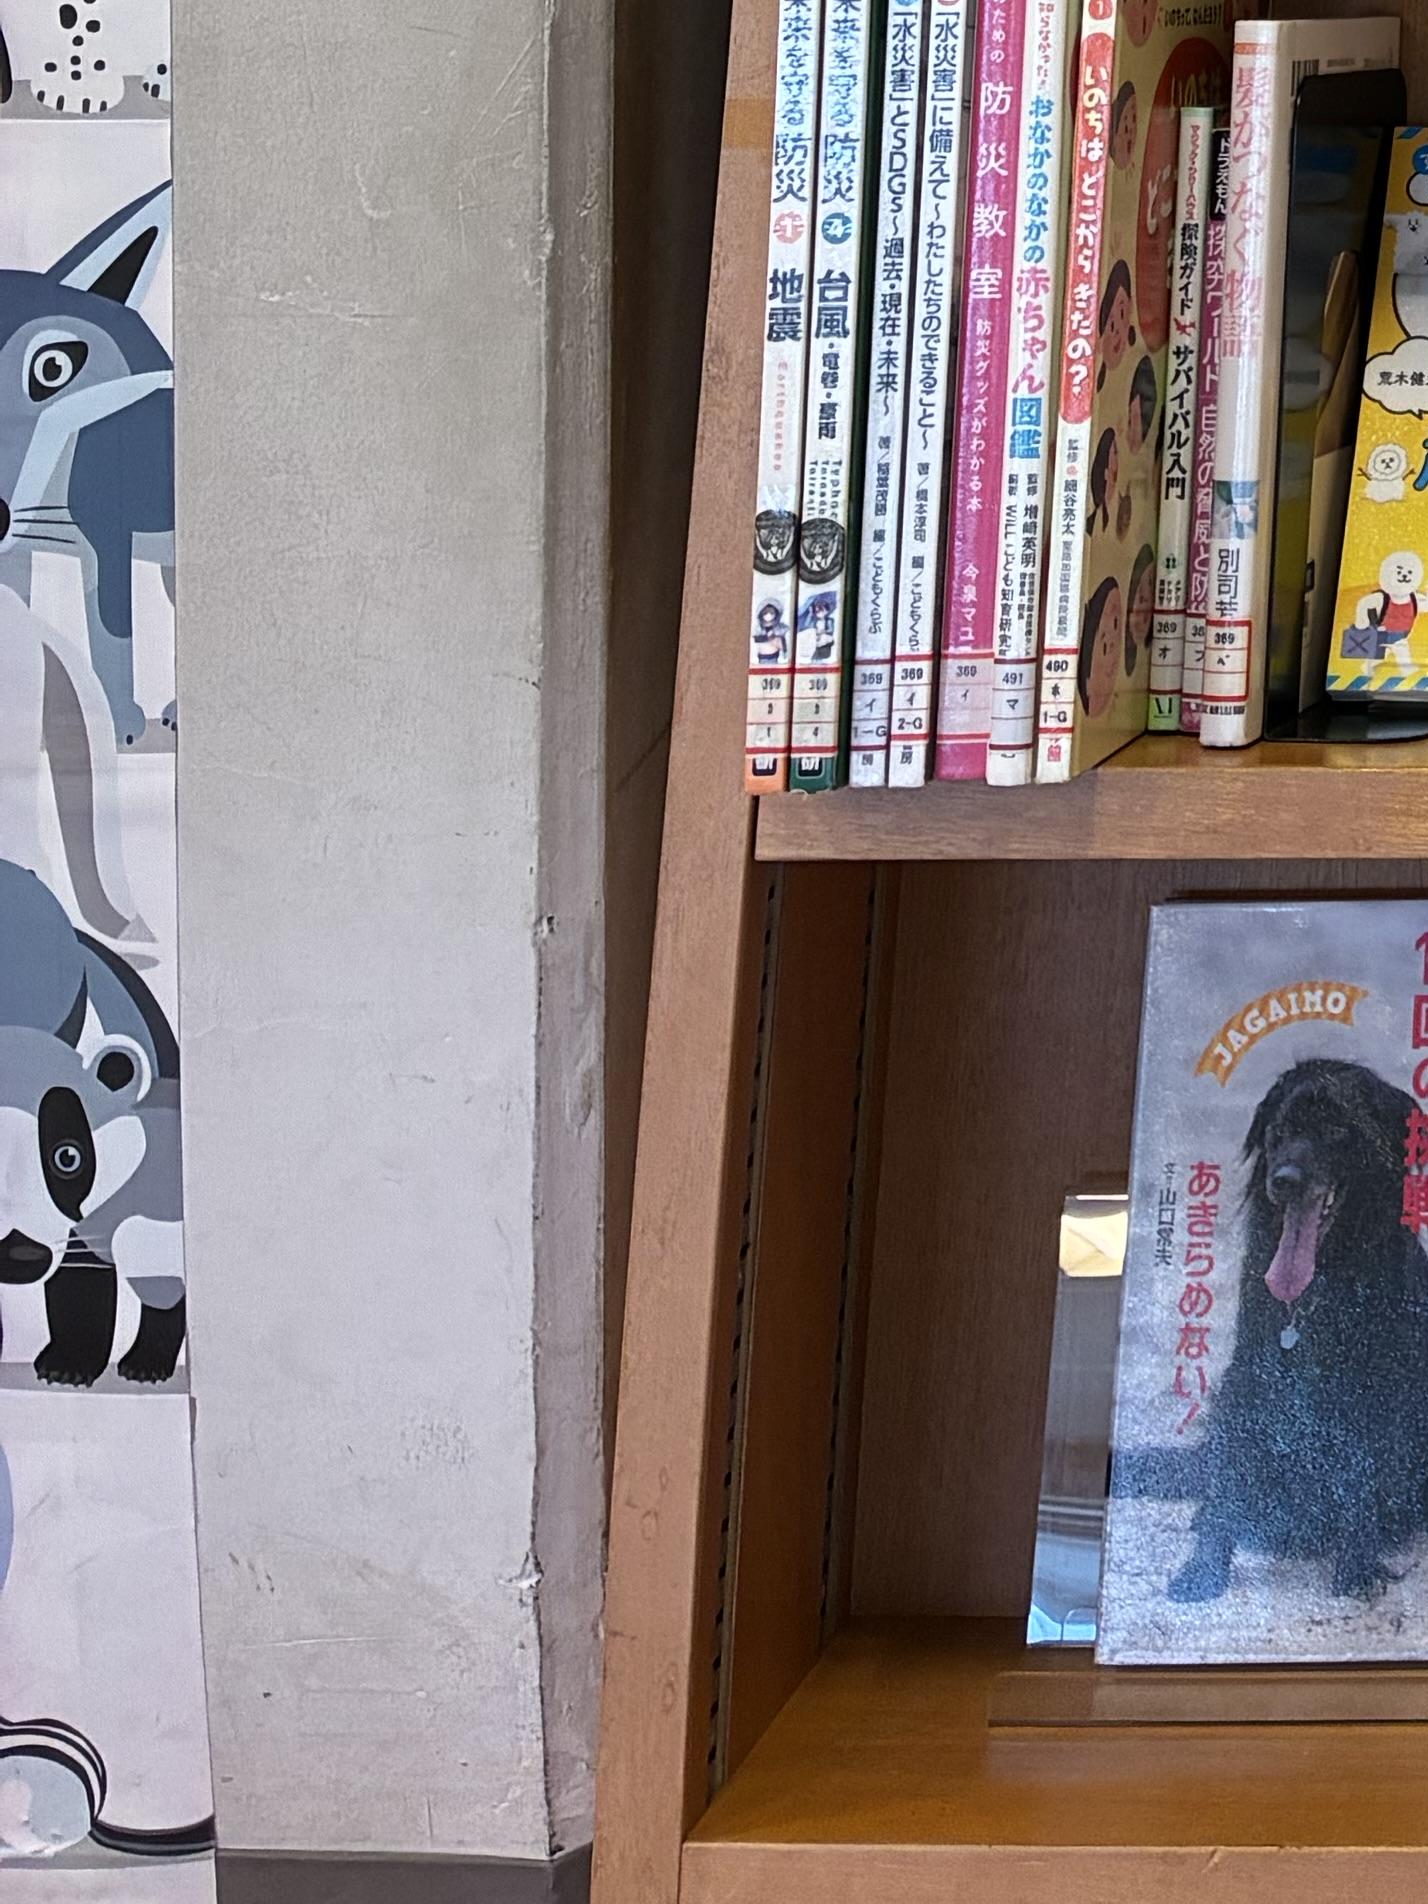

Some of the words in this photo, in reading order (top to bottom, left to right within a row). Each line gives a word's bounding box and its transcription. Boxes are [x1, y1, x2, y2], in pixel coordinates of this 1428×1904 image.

[1079, 64, 1108, 162] いのちは
[968, 82, 1015, 299] 防災教室
[1075, 169, 1103, 275] どこから
[1222, 65, 1271, 359] 髪がつなぐ物語
[767, 267, 805, 343] 地震
[1066, 282, 1094, 394] きたの?
[965, 317, 993, 512] 防災グッズがわかる本
[1164, 344, 1196, 501] サバイバル入門
[1209, 984, 1349, 1070] JAGAIMO
[1173, 1159, 1223, 1437] あきらめない!
